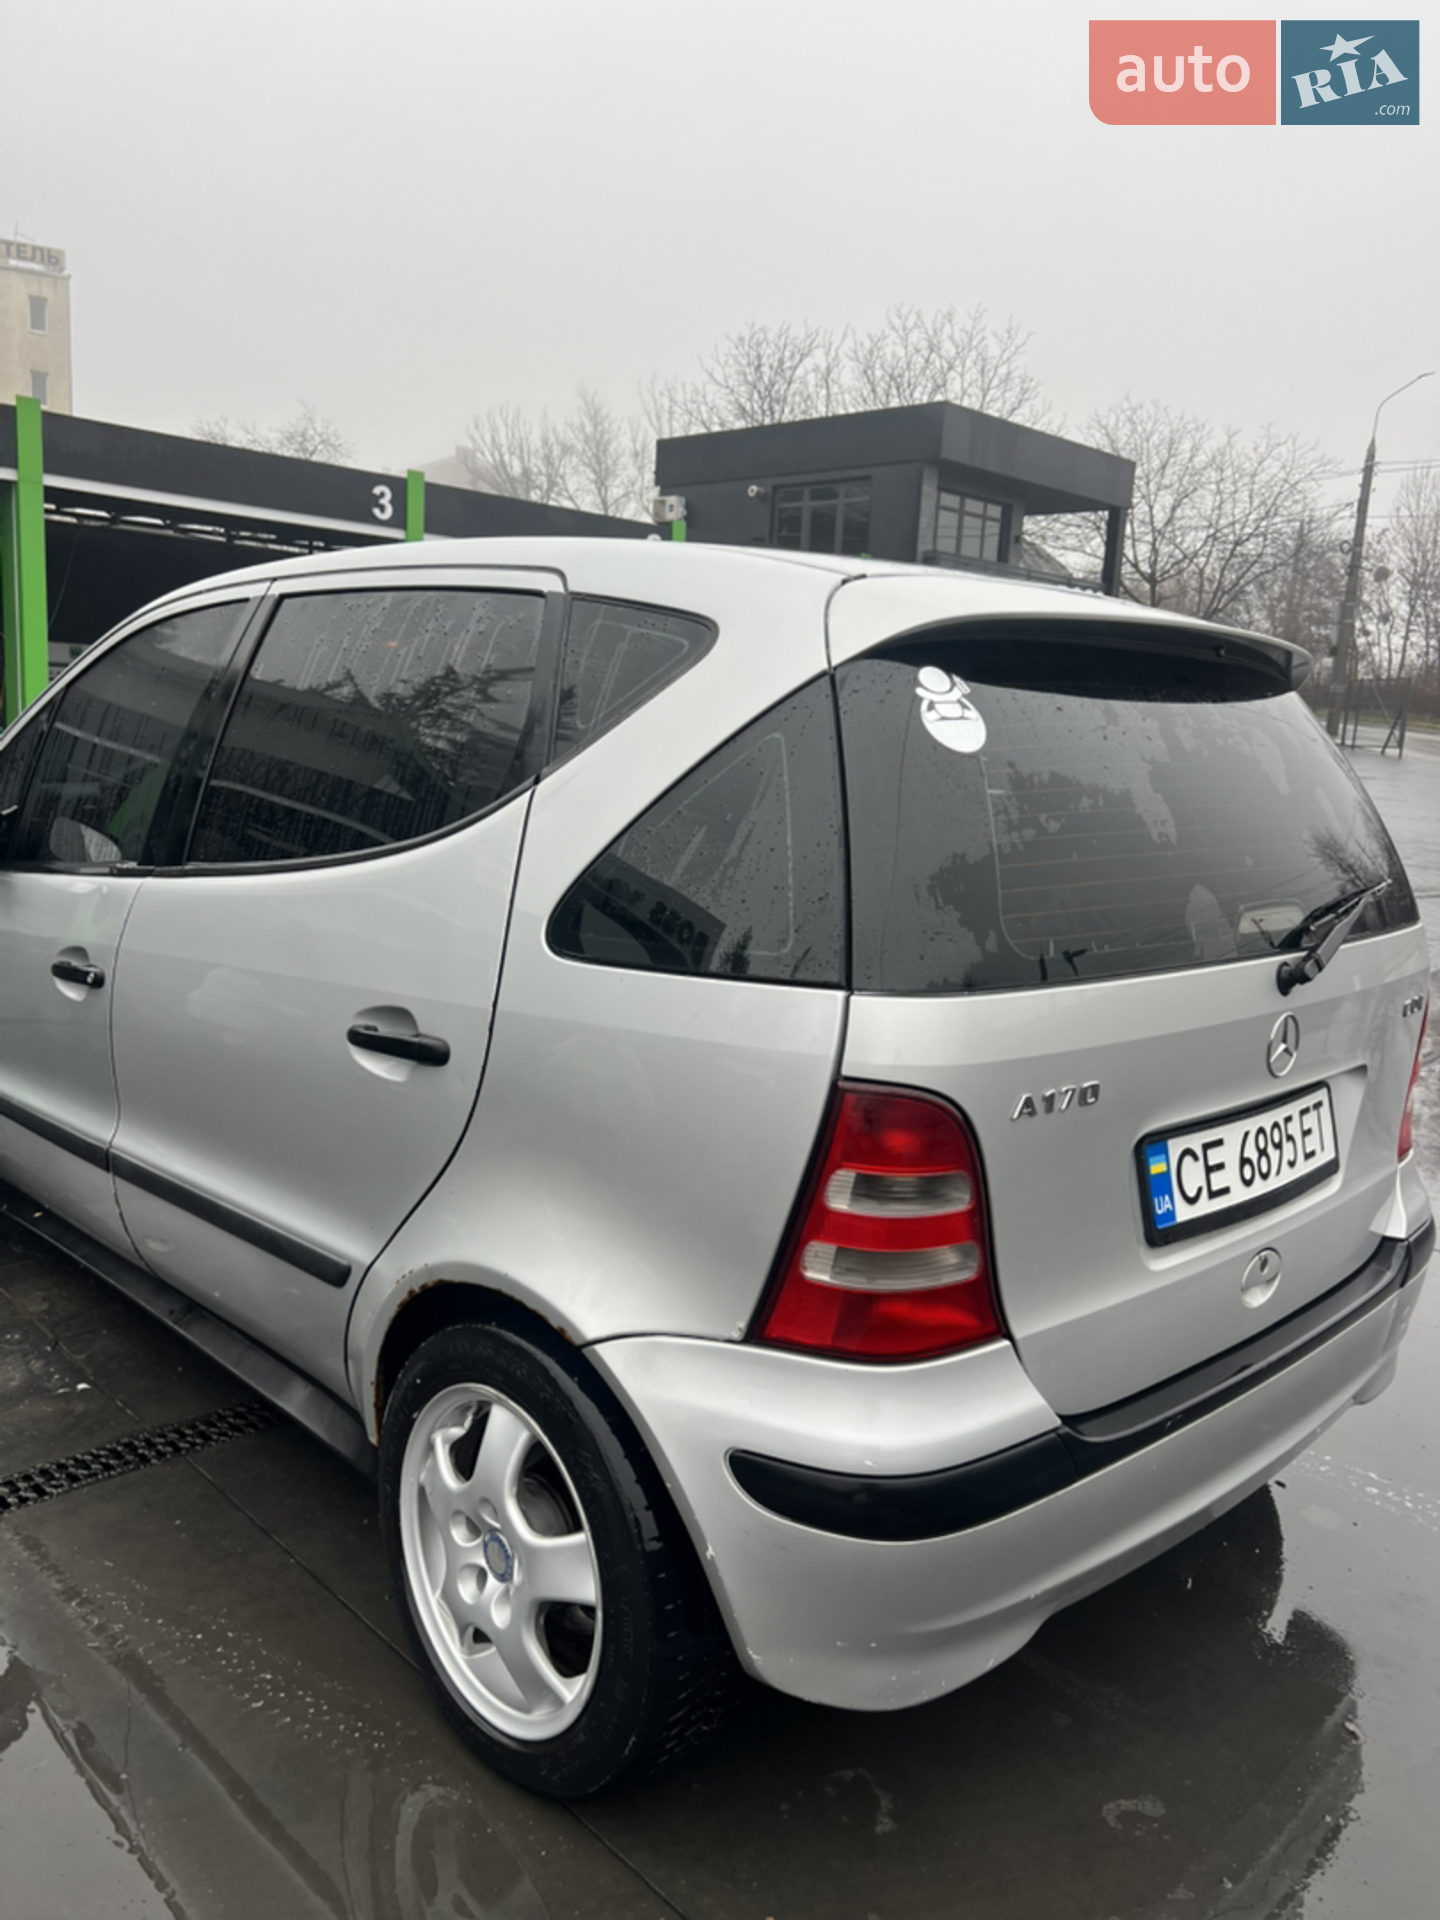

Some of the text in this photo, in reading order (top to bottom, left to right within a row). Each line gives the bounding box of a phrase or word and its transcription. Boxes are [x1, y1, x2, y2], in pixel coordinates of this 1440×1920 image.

[371, 484, 393, 521] 3
[1010, 1080, 1101, 1121] A170
[1176, 1100, 1325, 1206] CE 6895 ET
[1154, 1194, 1173, 1215] UA
